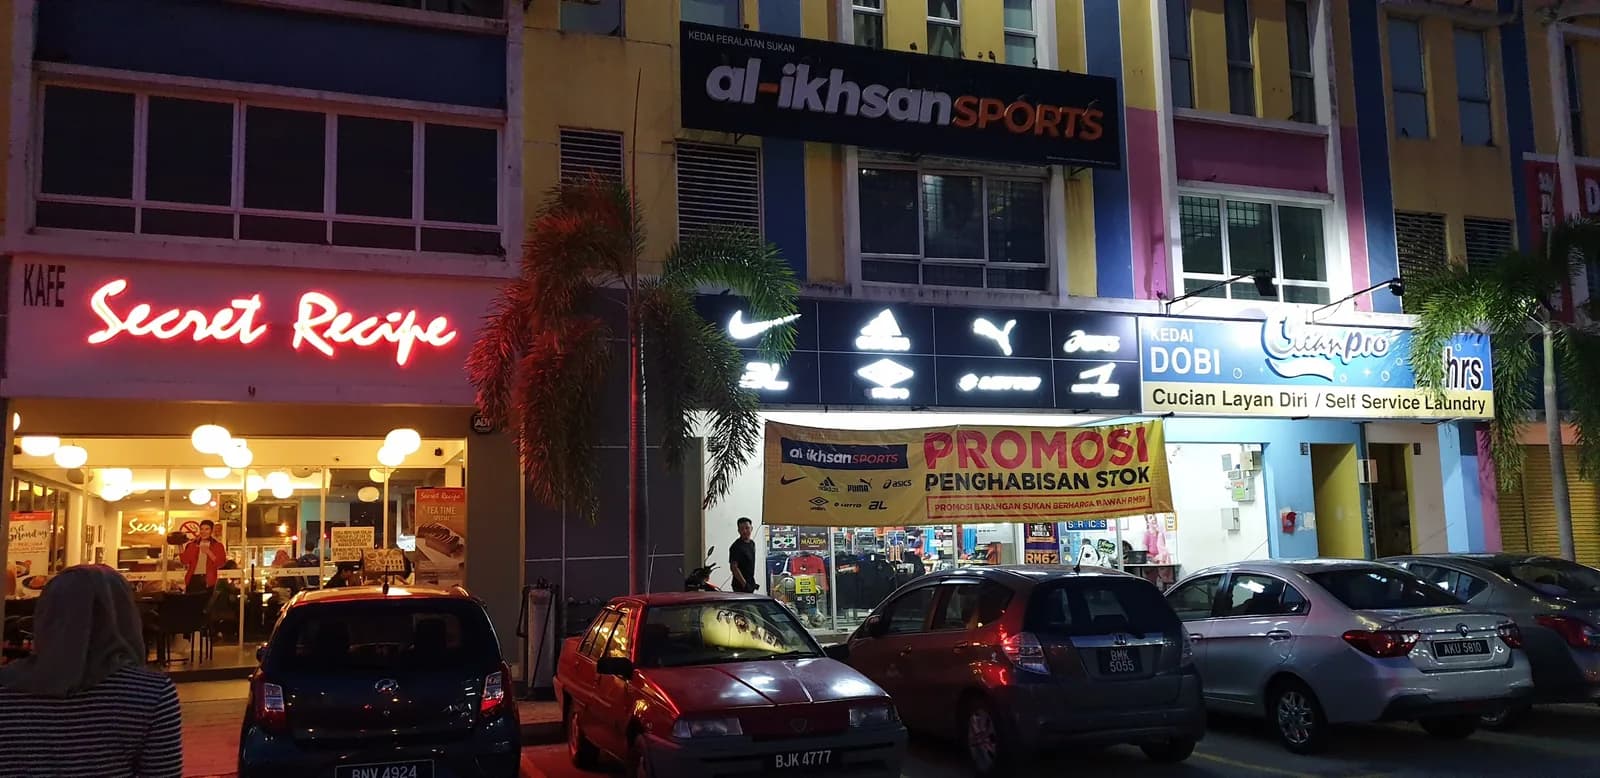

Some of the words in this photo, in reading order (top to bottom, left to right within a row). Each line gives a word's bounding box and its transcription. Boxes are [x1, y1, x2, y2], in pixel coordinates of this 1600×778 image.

[688, 30, 715, 42] KEDAI
[716, 34, 765, 49] PERALATAN
[767, 41, 795, 53] SUKAN
[23, 263, 65, 308] KAFE
[88, 278, 267, 345] Secret
[292, 291, 457, 367] Recipe
[1150, 327, 1193, 343] KEDAI
[1150, 346, 1221, 375] DOBI
[1152, 388, 1216, 406] Cucian
[1222, 390, 1273, 411] Layan
[1279, 391, 1308, 408] Diri
[1325, 393, 1357, 409] Self
[1361, 394, 1420, 411] Service
[1425, 395, 1486, 415] Laundry
[923, 426, 1150, 470] PROMOSI
[891, 478, 912, 488] asics
[925, 472, 1090, 491] PENGHABISAN
[1096, 466, 1150, 488] STOK
[935, 503, 973, 511] PROMOSI
[974, 502, 1021, 511] BARANGAN
[1022, 502, 1052, 511] SUKAN
[1053, 500, 1095, 510] BERHARGA
[1096, 496, 1127, 507] BAWAH
[127, 517, 174, 535] Secr
[1026, 553, 1058, 564] RM62
[806, 595, 816, 605] 59
[1444, 643, 1461, 655] AKU
[1110, 661, 1135, 673] 5055
[775, 752, 799, 768] BJK
[802, 750, 832, 766] 4777
[382, 765, 417, 778] 4924
